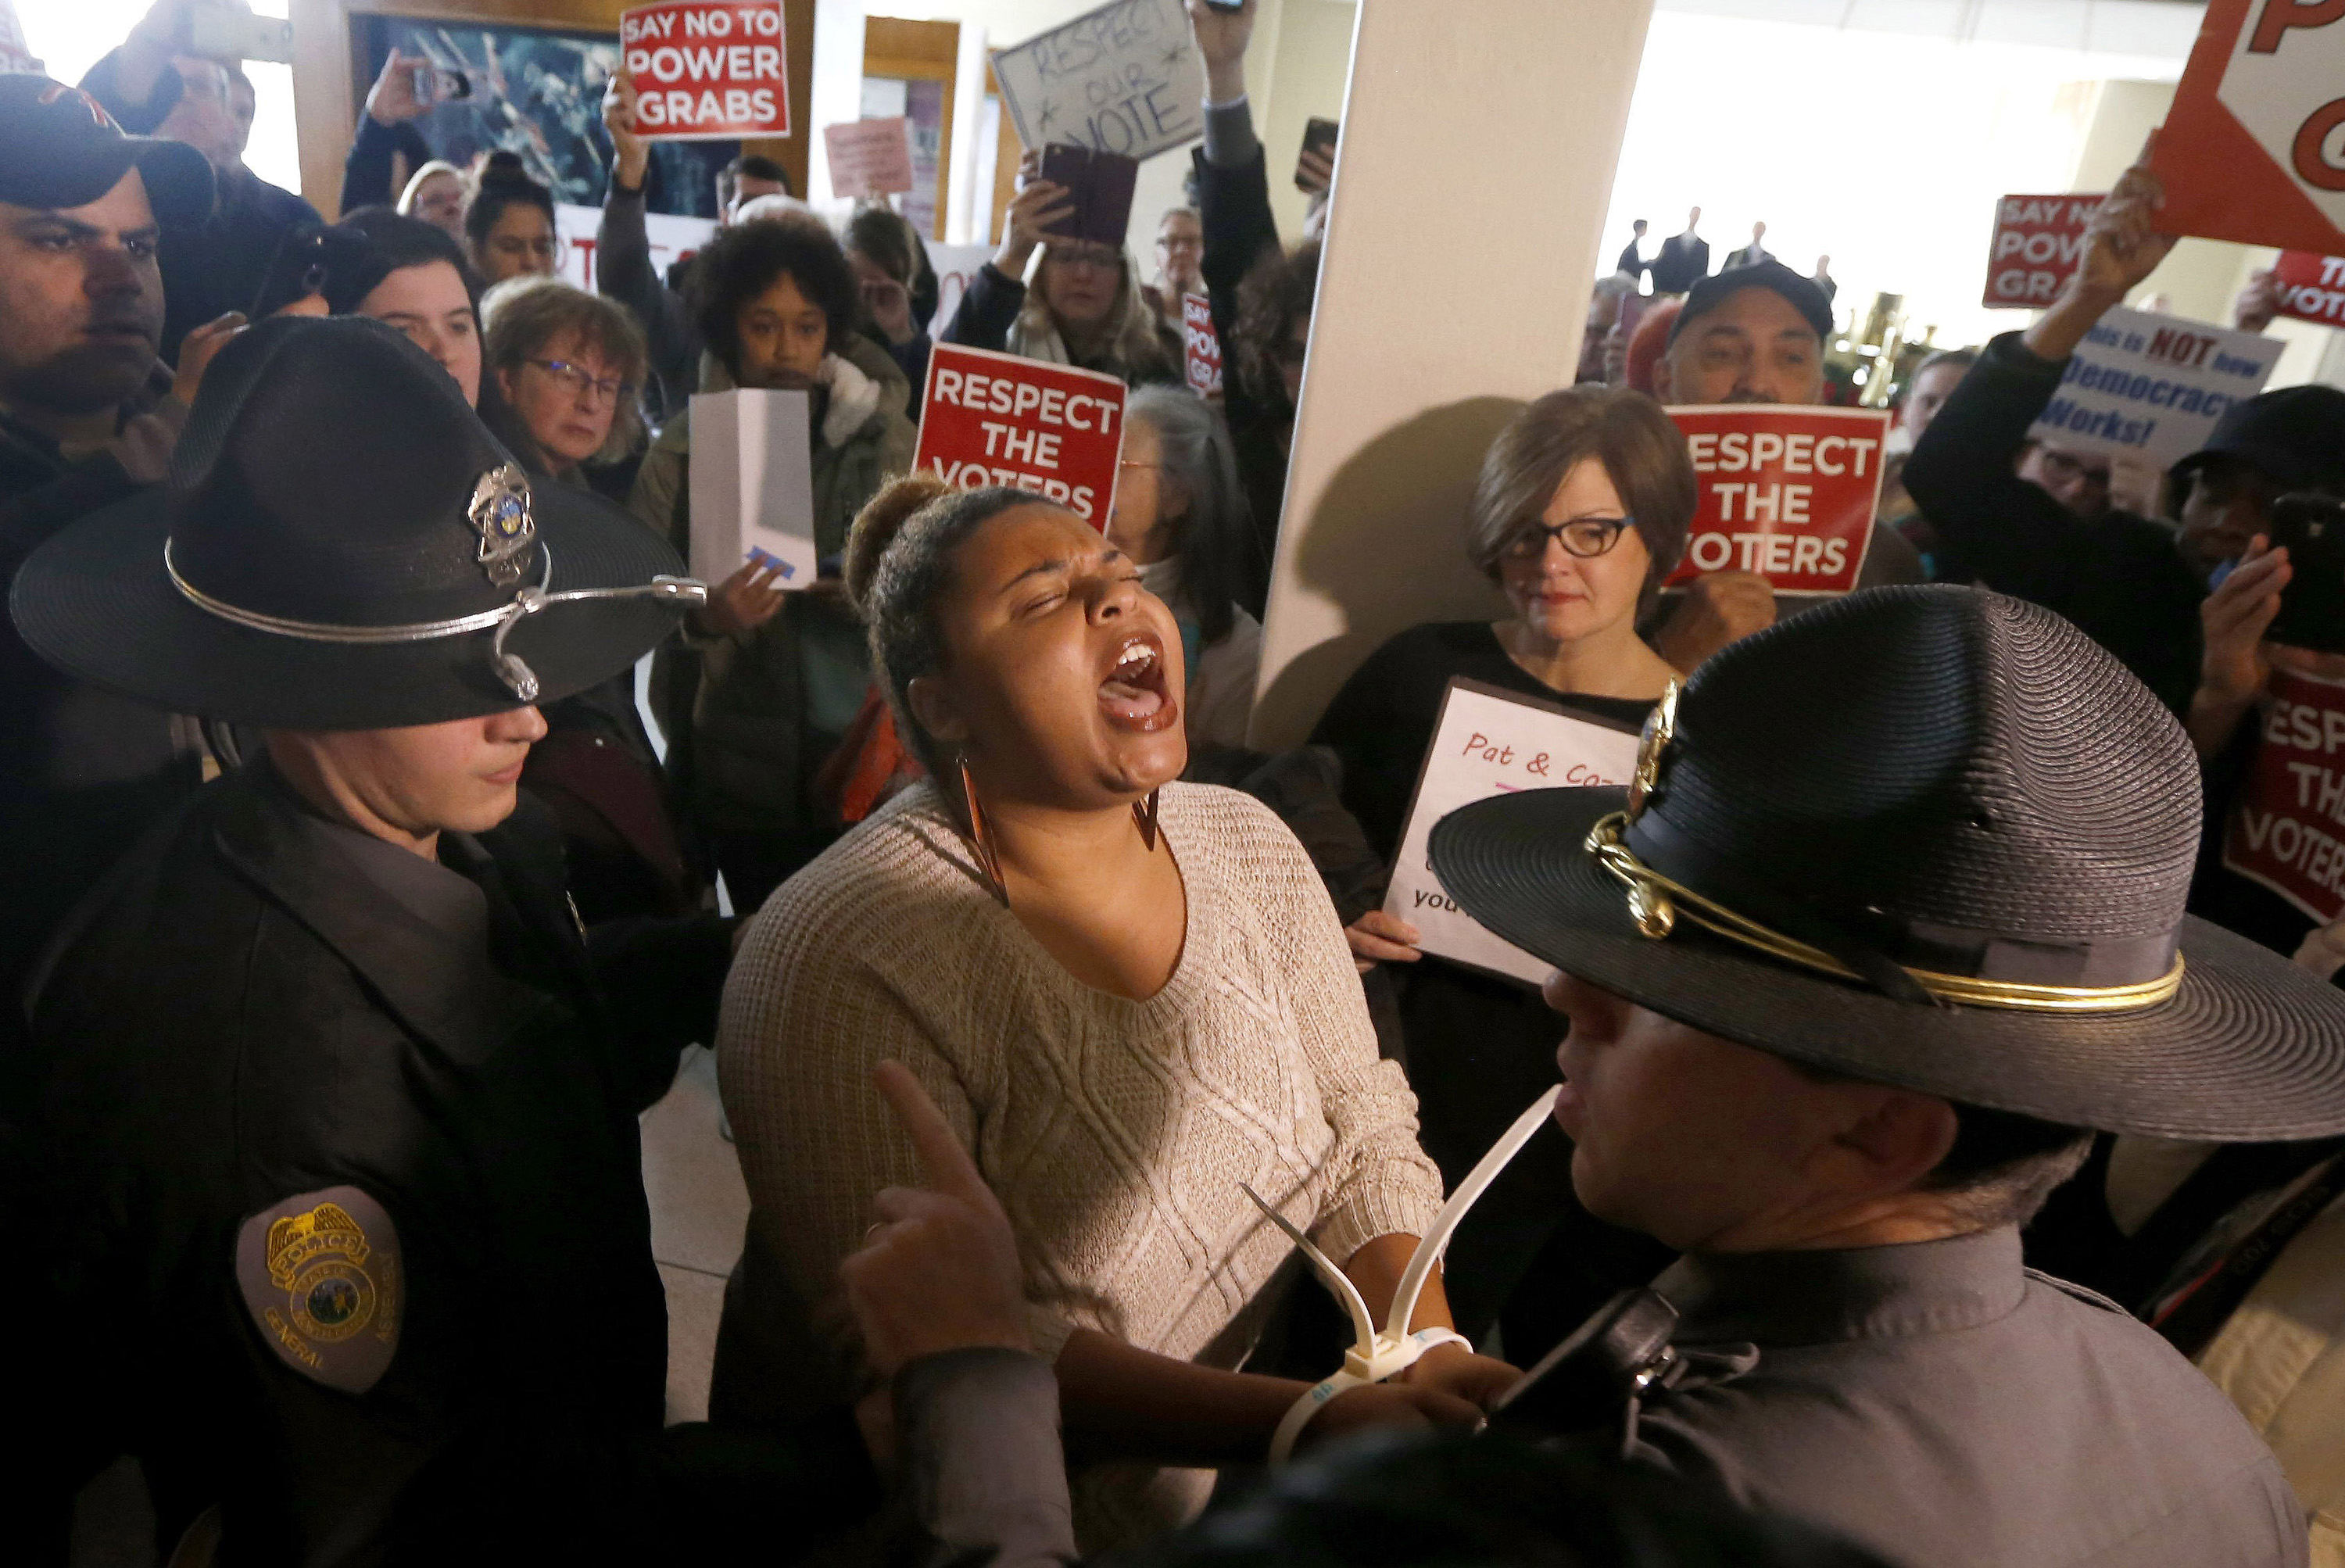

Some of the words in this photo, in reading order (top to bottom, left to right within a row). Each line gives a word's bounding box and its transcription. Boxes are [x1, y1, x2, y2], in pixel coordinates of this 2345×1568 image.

[625, 12, 677, 41] SAY
[684, 10, 732, 38] NO
[738, 10, 780, 37] TO
[627, 45, 781, 83] POWER
[1086, 63, 1155, 106] OUR
[637, 88, 778, 125] GRABS
[1065, 82, 1194, 154] VOTE
[2001, 199, 2064, 226] SAY
[2146, 327, 2218, 366] NOT
[934, 368, 1119, 435] RESPECT
[2040, 398, 2155, 447] Works!
[981, 421, 1063, 469] THE
[1688, 432, 1878, 478] ESPECT
[1712, 482, 1813, 524] THE
[1687, 532, 1849, 576] OTERS
[1462, 732, 1515, 764] Pat
[1527, 752, 1549, 776] &
